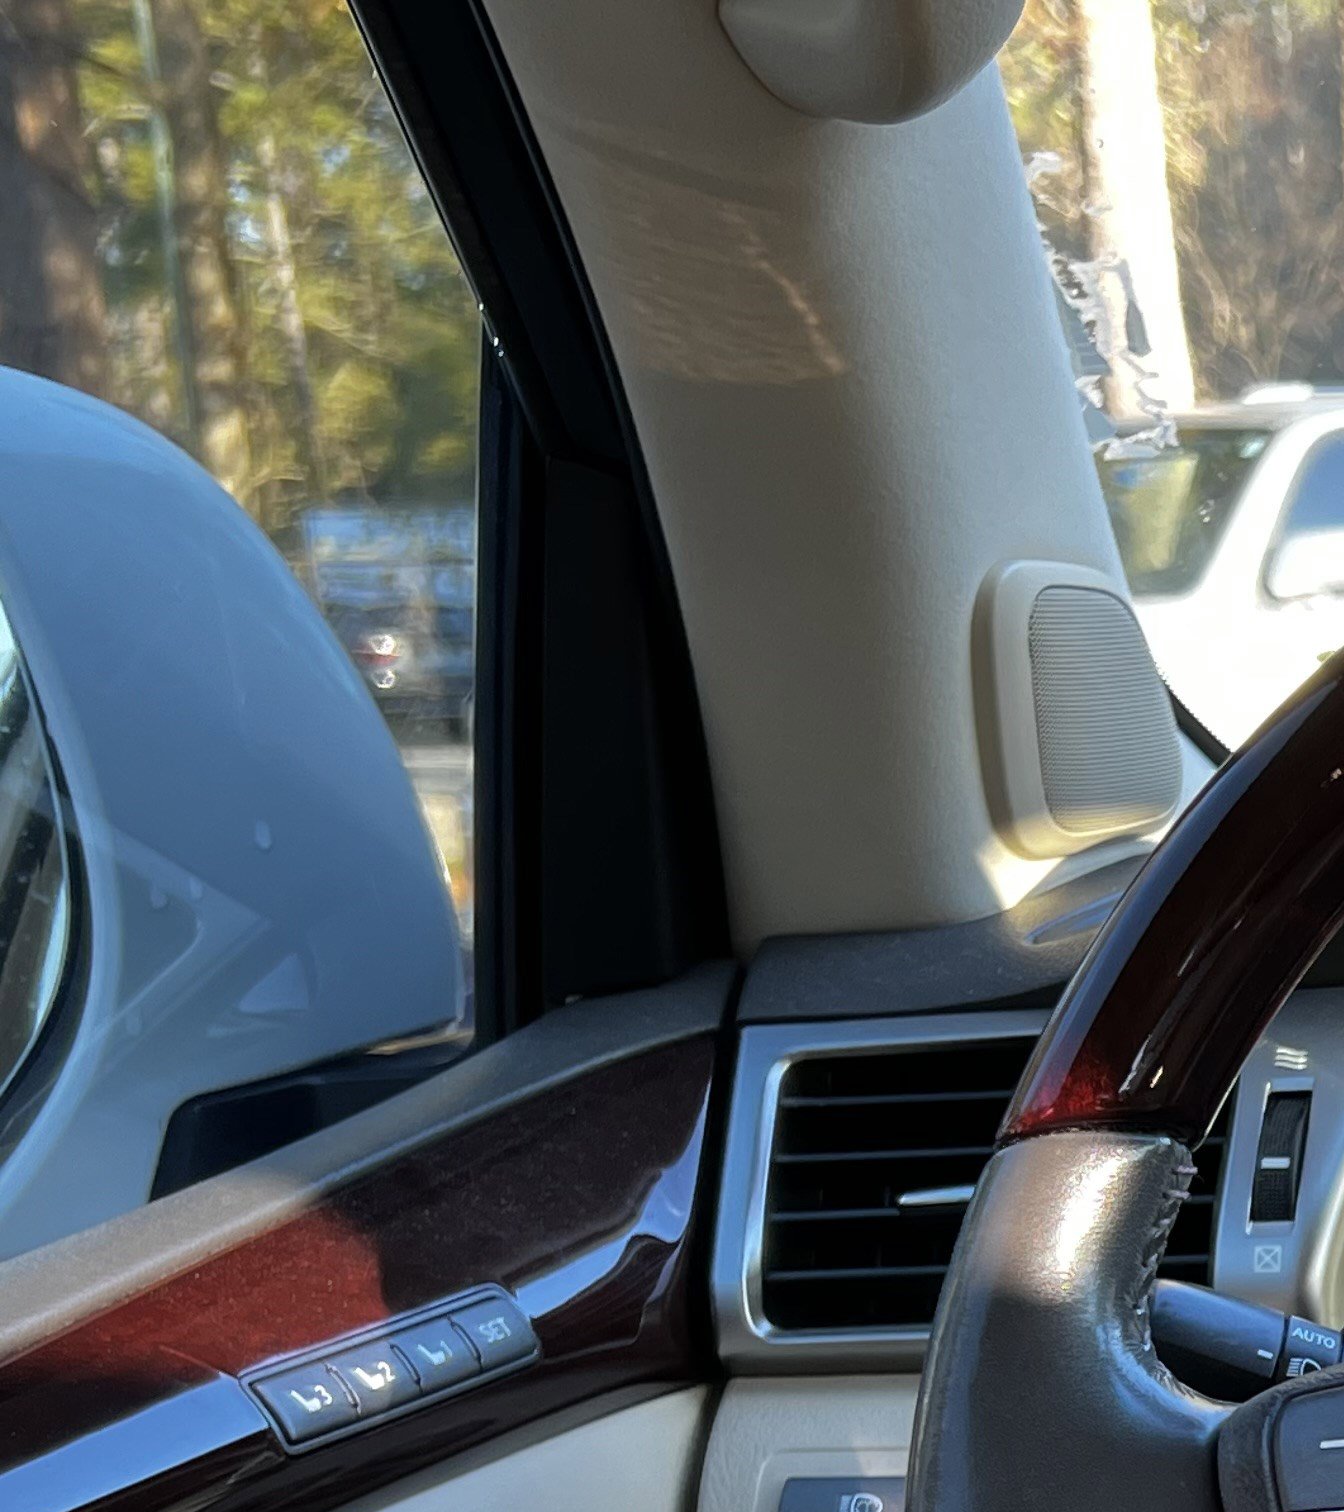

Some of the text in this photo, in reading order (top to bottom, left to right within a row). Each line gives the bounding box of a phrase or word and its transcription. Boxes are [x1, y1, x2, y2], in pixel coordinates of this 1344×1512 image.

[478, 1316, 511, 1344] SET
[1291, 1327, 1336, 1349] AUTO
[376, 1361, 396, 1383] 2
[314, 1384, 333, 1406] 3
